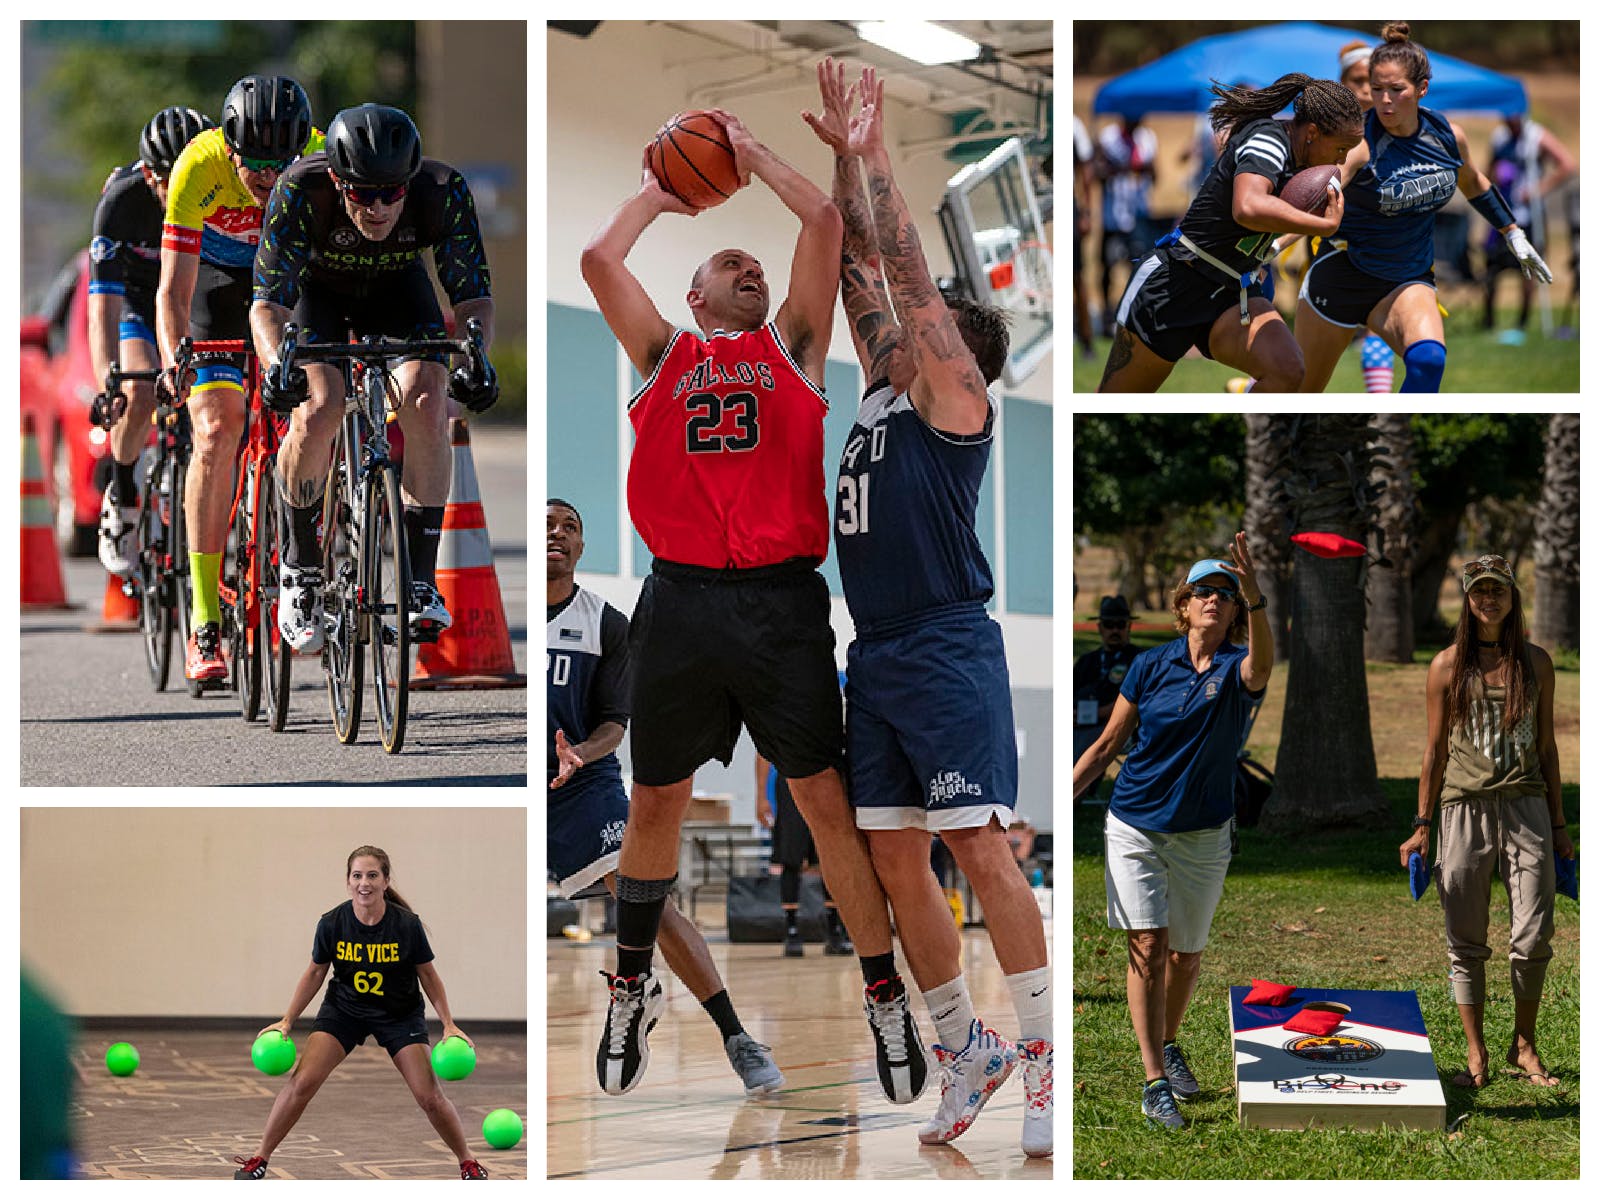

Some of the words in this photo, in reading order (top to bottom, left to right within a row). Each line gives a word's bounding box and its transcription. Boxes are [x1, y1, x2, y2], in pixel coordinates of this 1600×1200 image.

[1379, 171, 1456, 205] LAPD
[323, 247, 424, 265] MONSTE
[685, 391, 760, 454] 23
[838, 472, 870, 536] 31
[927, 776, 982, 807] Angeles
[937, 770, 961, 785] Los
[336, 941, 363, 963] SAC
[366, 943, 400, 963] VICE
[353, 970, 384, 996] 62
